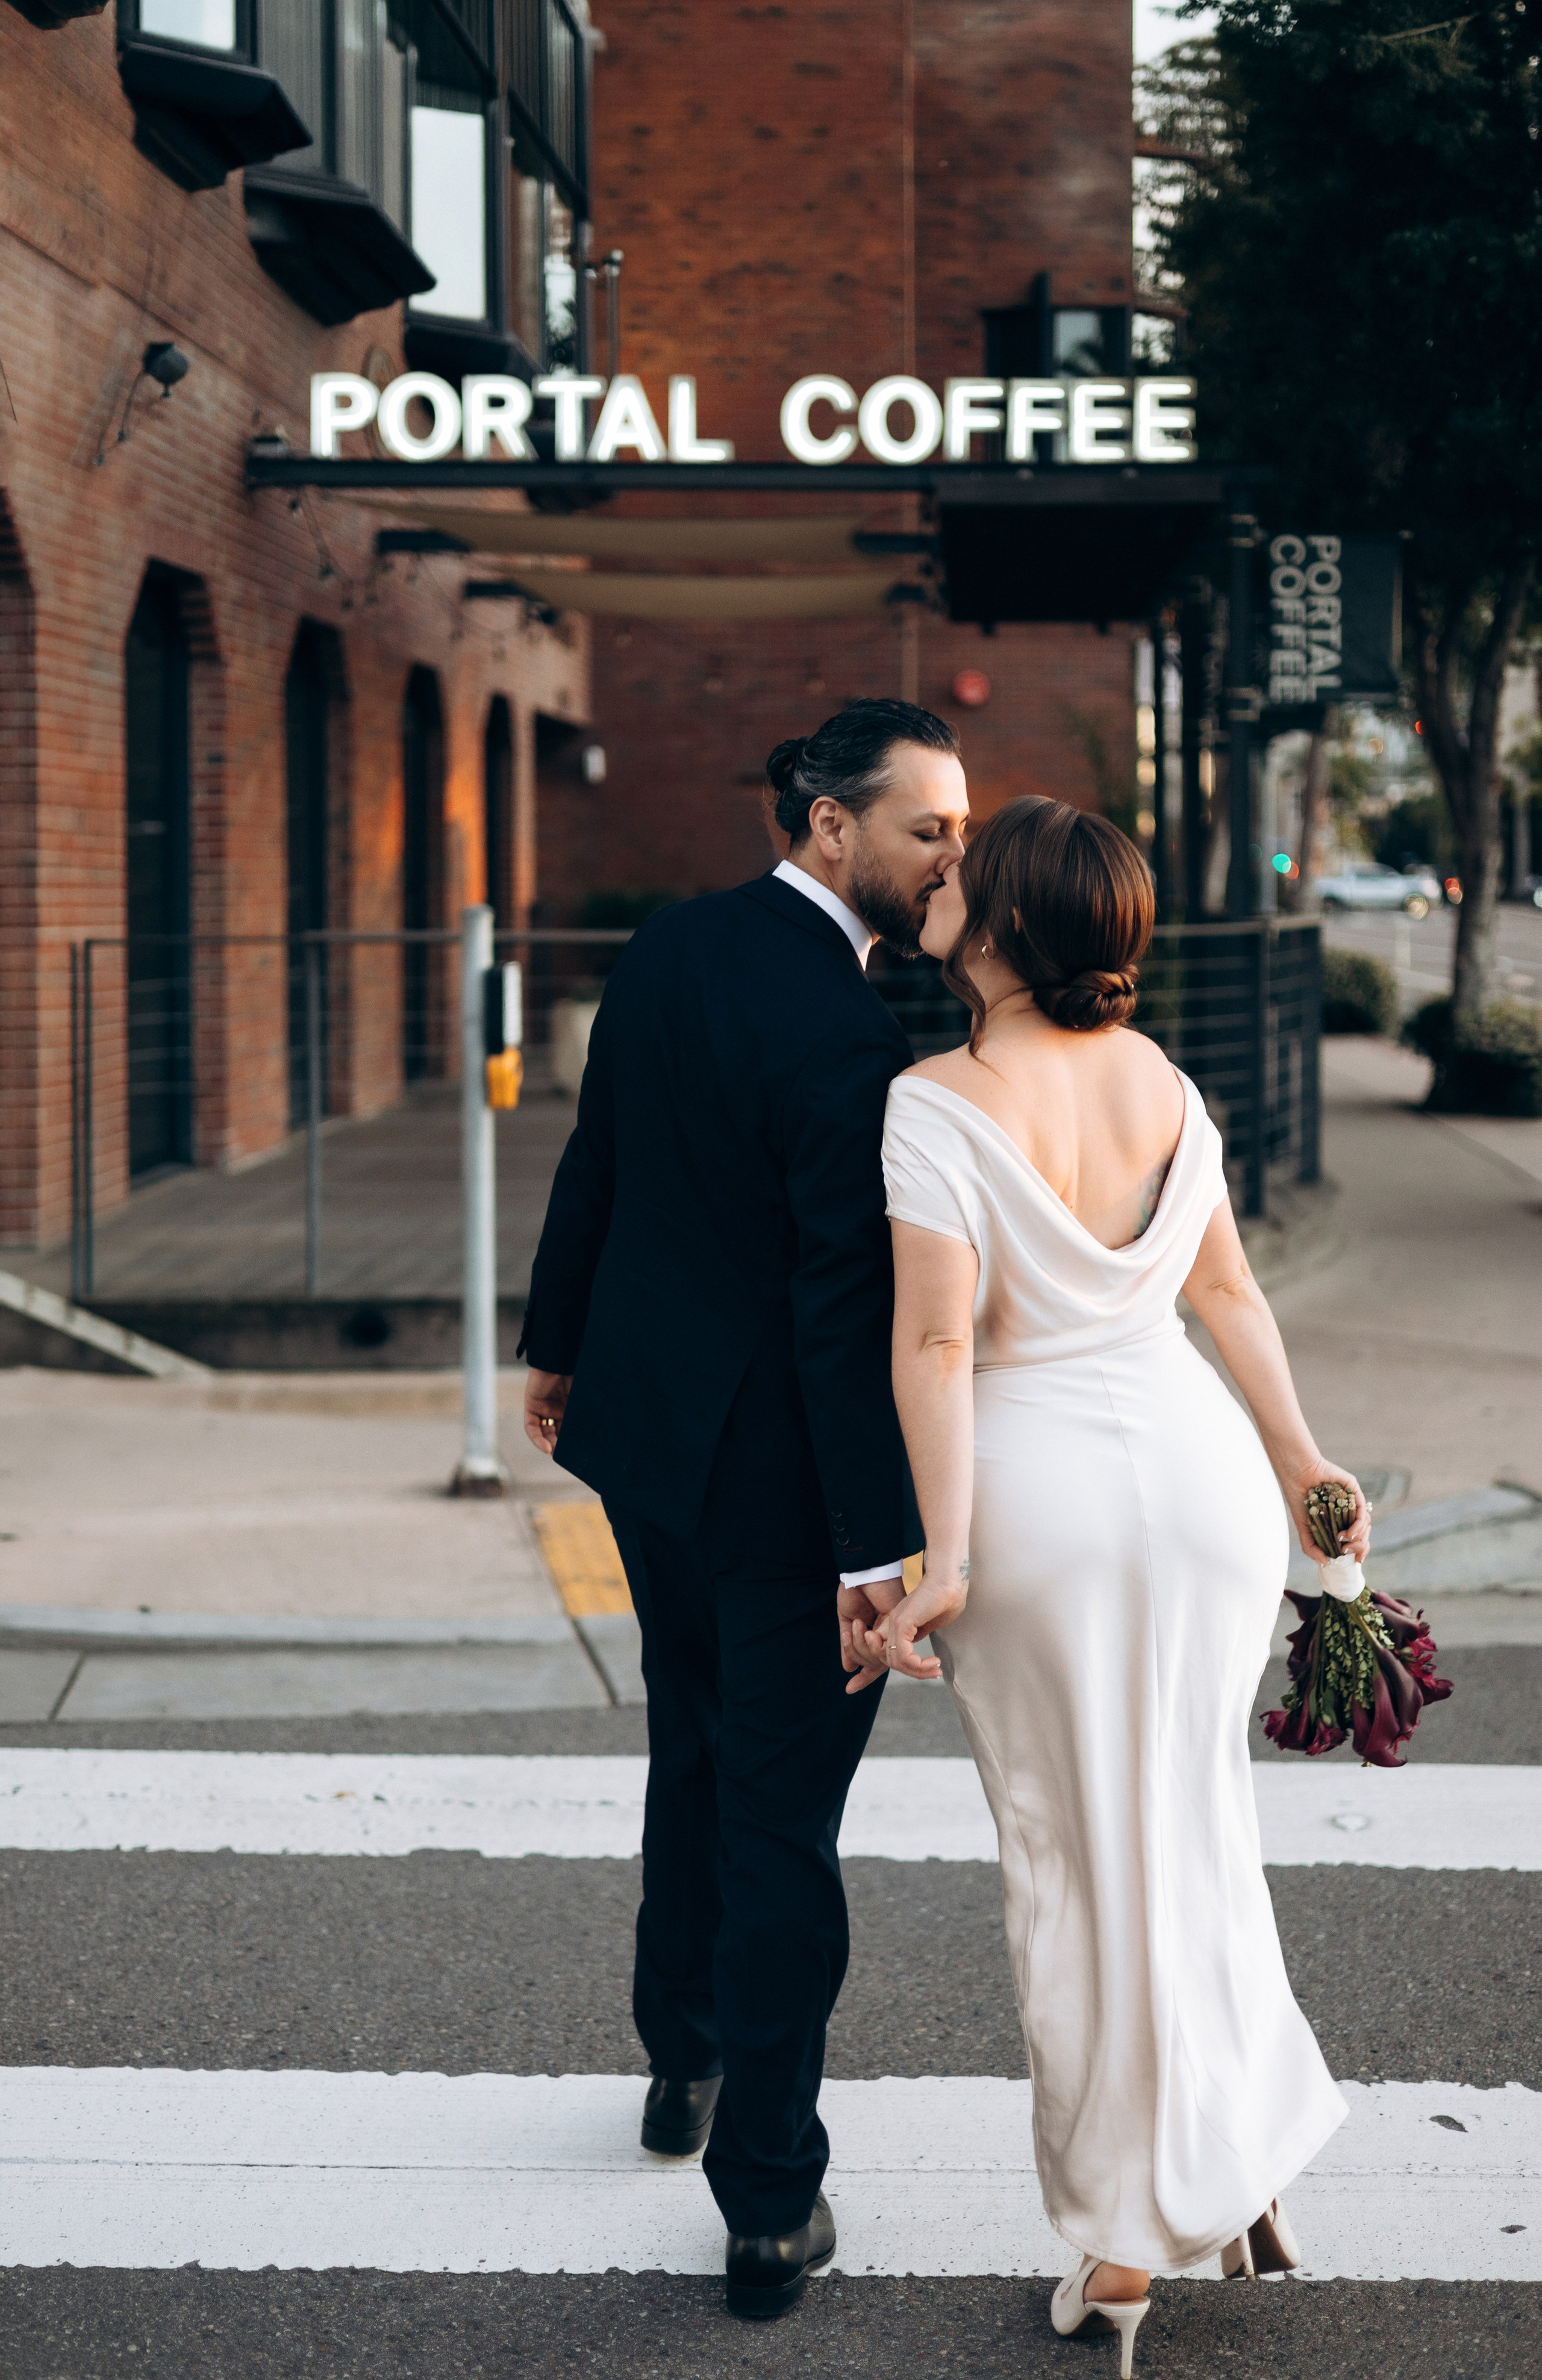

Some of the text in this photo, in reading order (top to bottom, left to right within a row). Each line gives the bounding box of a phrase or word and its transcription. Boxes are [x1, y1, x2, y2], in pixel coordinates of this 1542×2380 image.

[310, 372, 1197, 466] PORTAL COFFEE
[1270, 534, 1306, 703] COFFEE
[1306, 535, 1342, 702] PORTAL
